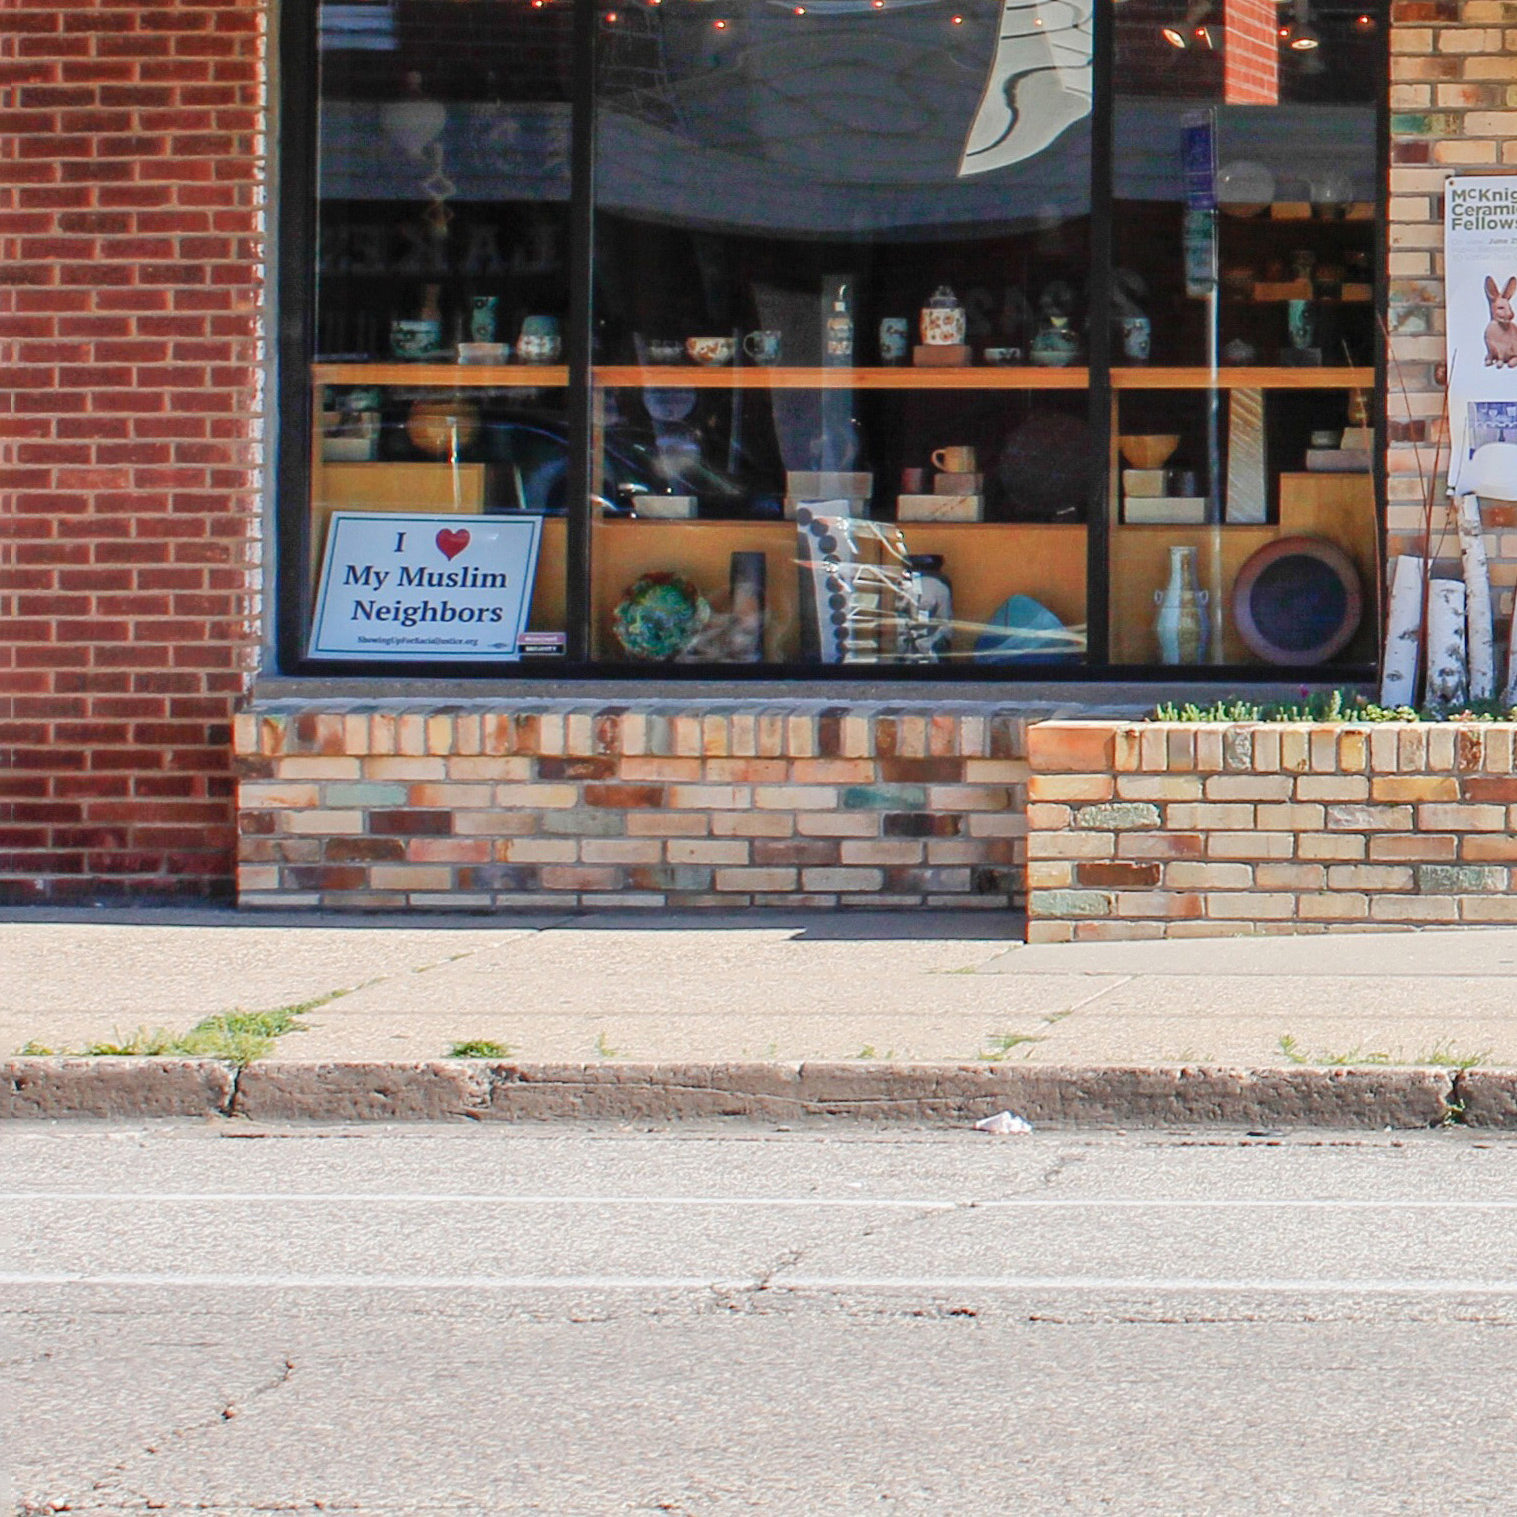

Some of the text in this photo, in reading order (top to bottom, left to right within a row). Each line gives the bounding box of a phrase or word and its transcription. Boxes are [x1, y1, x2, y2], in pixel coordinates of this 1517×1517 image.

[394, 531, 406, 553] I
[343, 564, 508, 591] My Muslim
[350, 599, 503, 627] Neighbors
